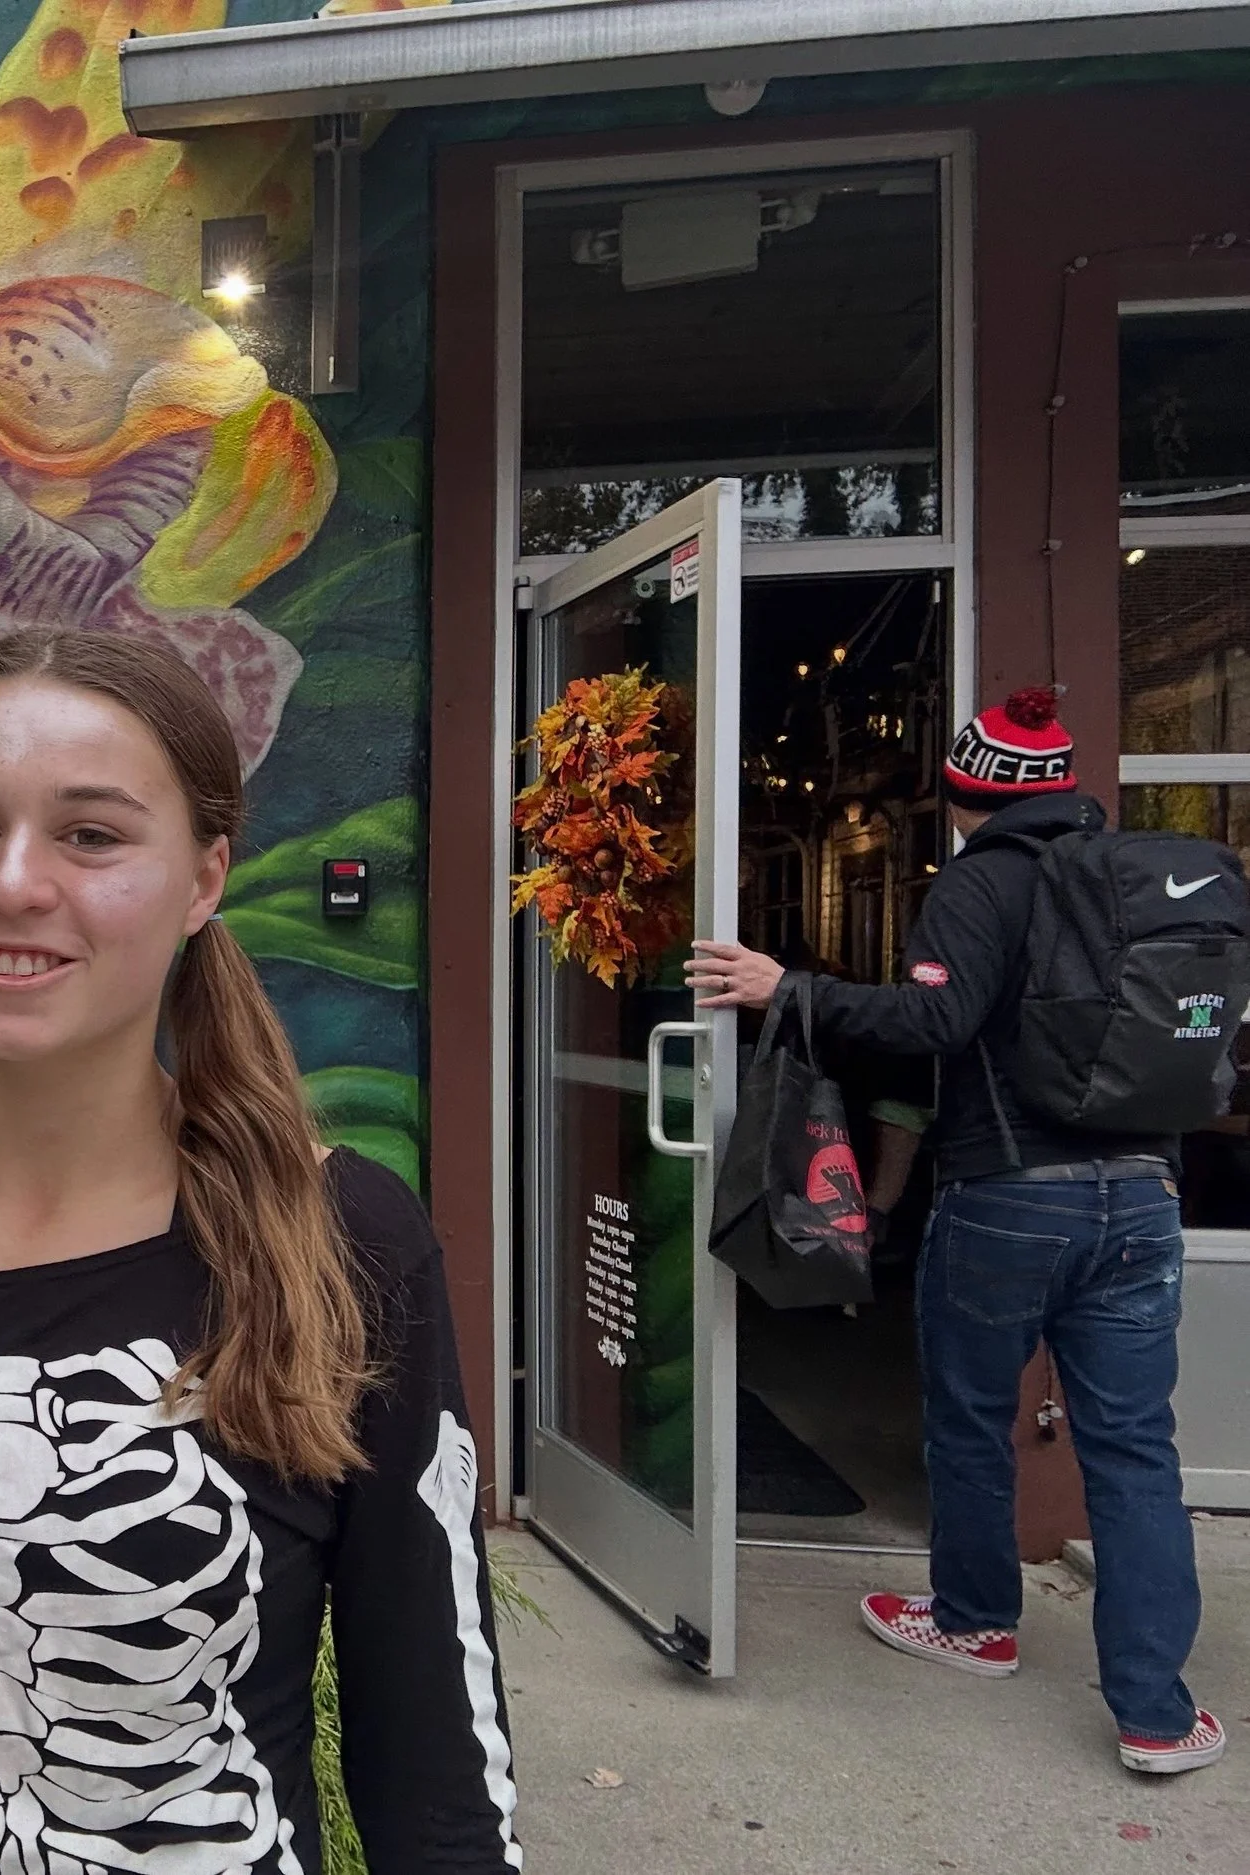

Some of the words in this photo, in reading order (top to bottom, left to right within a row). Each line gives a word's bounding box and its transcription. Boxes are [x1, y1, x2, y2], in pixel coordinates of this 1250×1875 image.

[1178, 993, 1225, 1011] WILDCAT
[1190, 1006, 1212, 1027] N
[1174, 1026, 1221, 1038] ATHLETICS
[595, 1194, 629, 1221] HOURS
[587, 1215, 606, 1233] Monday
[592, 1232, 611, 1251] Tuesday
[612, 1240, 629, 1255] Closed
[590, 1246, 615, 1268] Wednesday
[585, 1260, 606, 1280] Thursday
[589, 1276, 604, 1295] Friday
